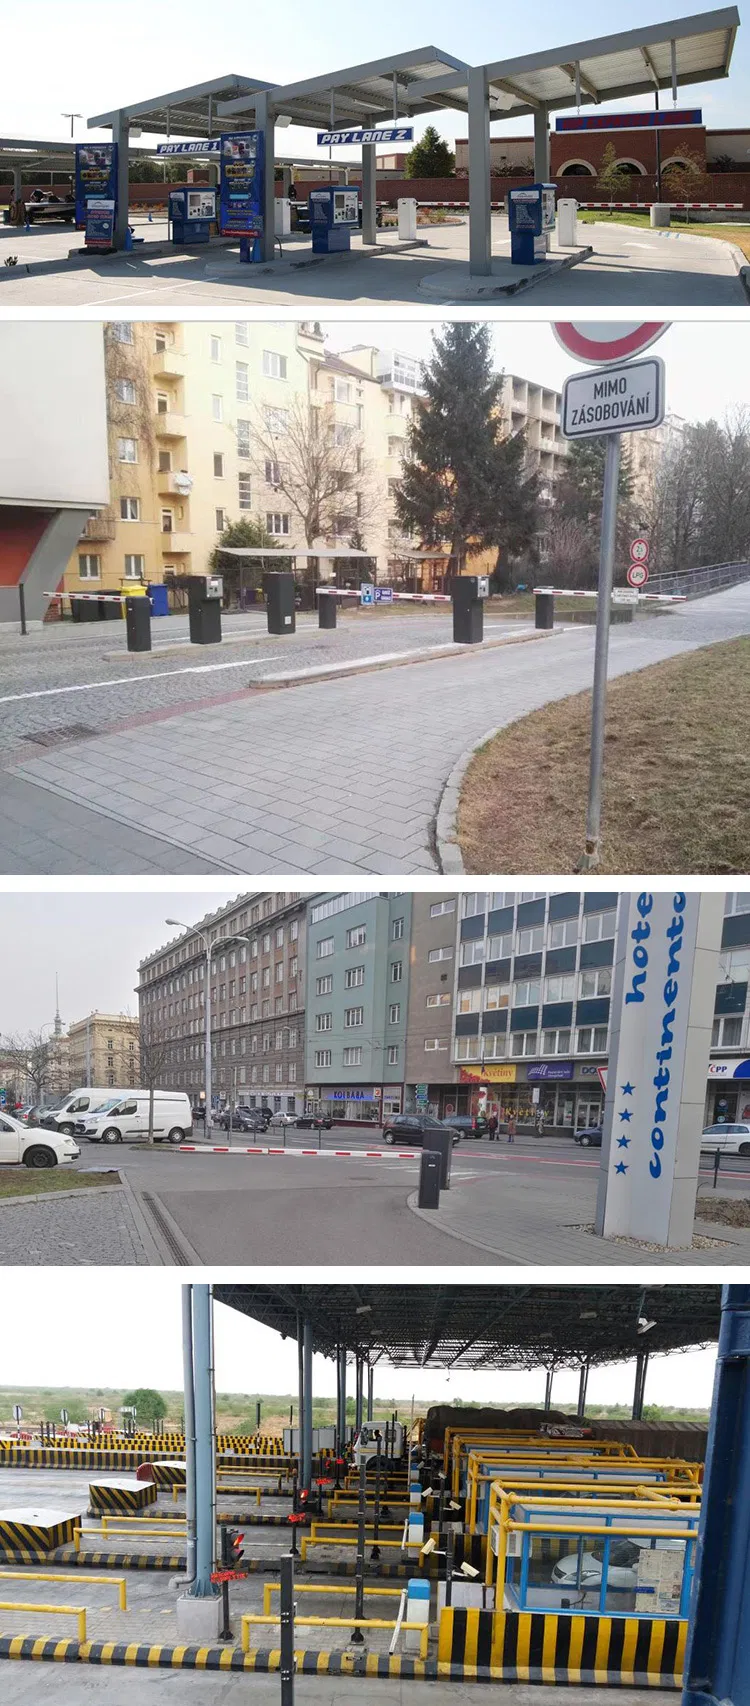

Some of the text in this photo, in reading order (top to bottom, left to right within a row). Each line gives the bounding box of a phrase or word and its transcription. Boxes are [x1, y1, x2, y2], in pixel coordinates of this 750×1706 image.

[321, 129, 408, 144] PAY LANE 2
[160, 142, 218, 153] PAY LANE 1
[593, 377, 627, 400] MIMO
[571, 392, 650, 426] ZÁSOBOVÁNÍ
